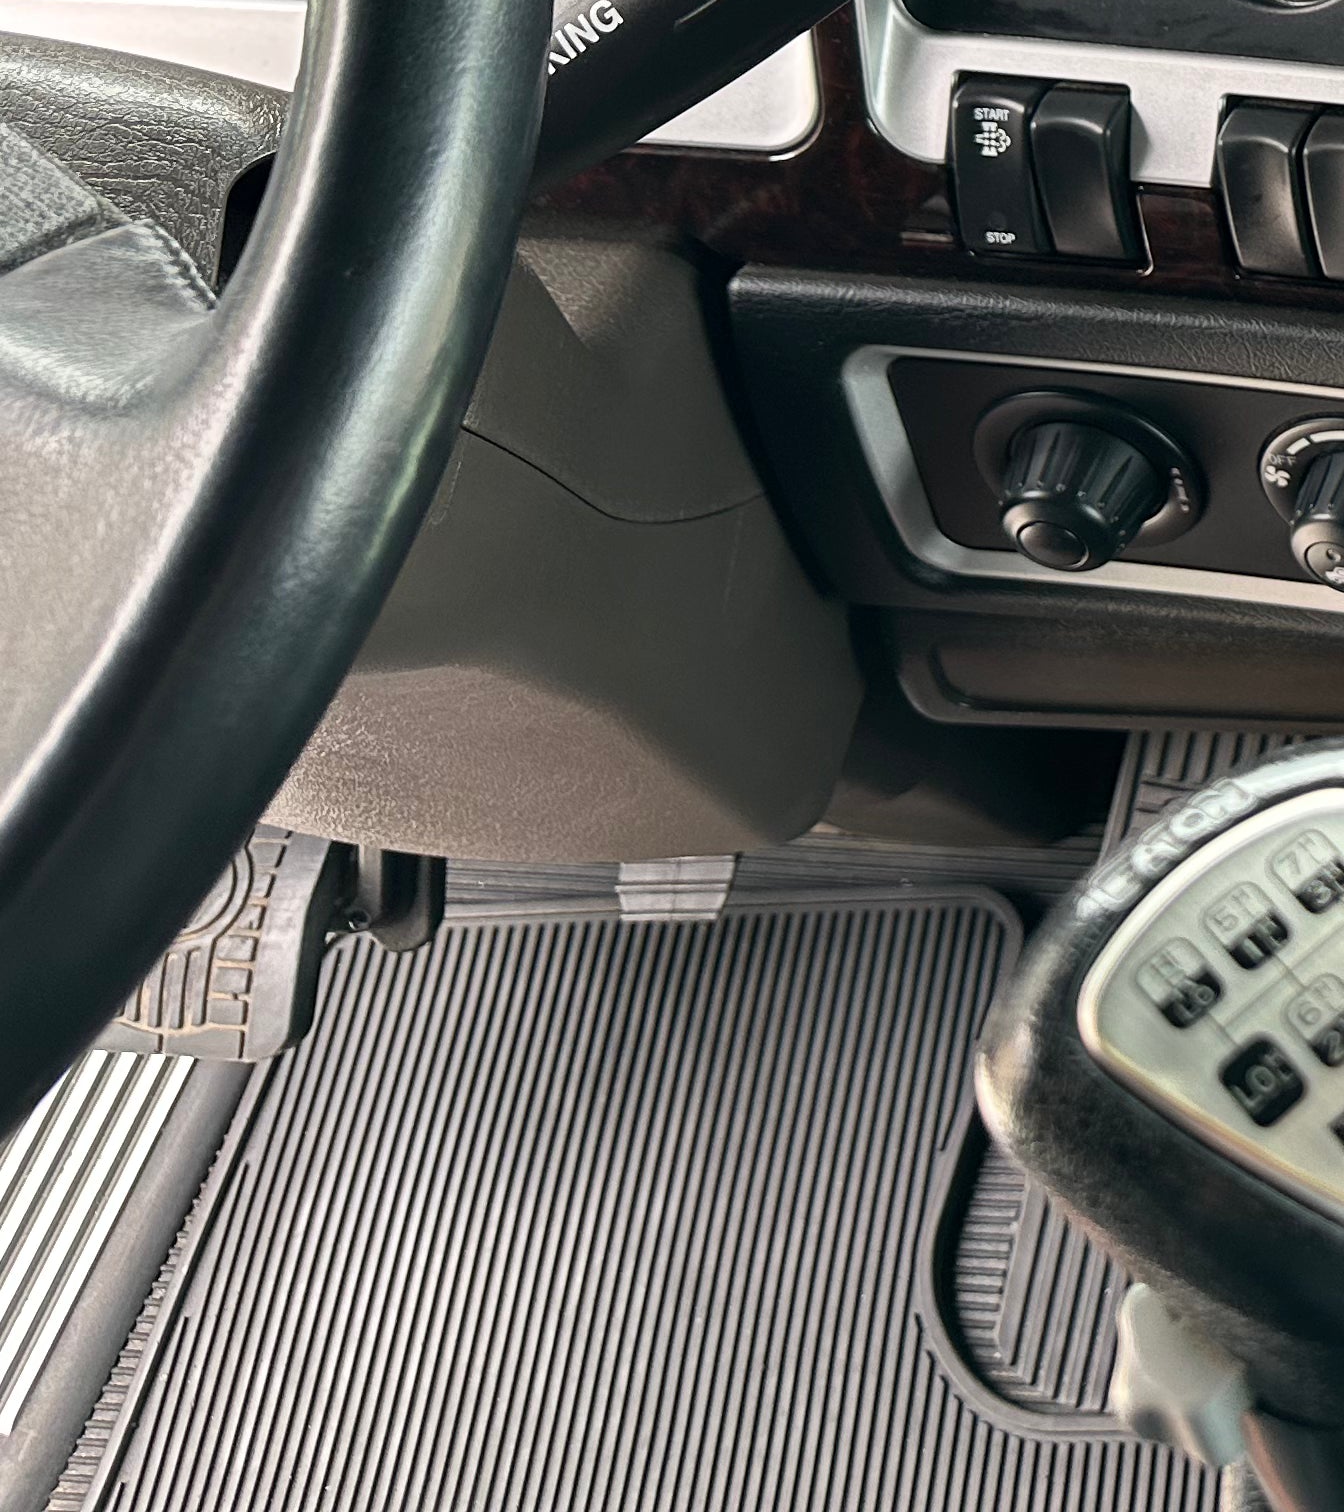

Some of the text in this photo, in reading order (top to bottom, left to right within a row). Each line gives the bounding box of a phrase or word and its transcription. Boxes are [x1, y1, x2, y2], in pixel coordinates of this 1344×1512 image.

[973, 107, 1010, 122] START
[985, 230, 1017, 245] STOP
[1268, 453, 1297, 467] OFF
[1278, 850, 1303, 876] 7
[1210, 905, 1240, 933] 5
[1295, 1000, 1323, 1028] 6
